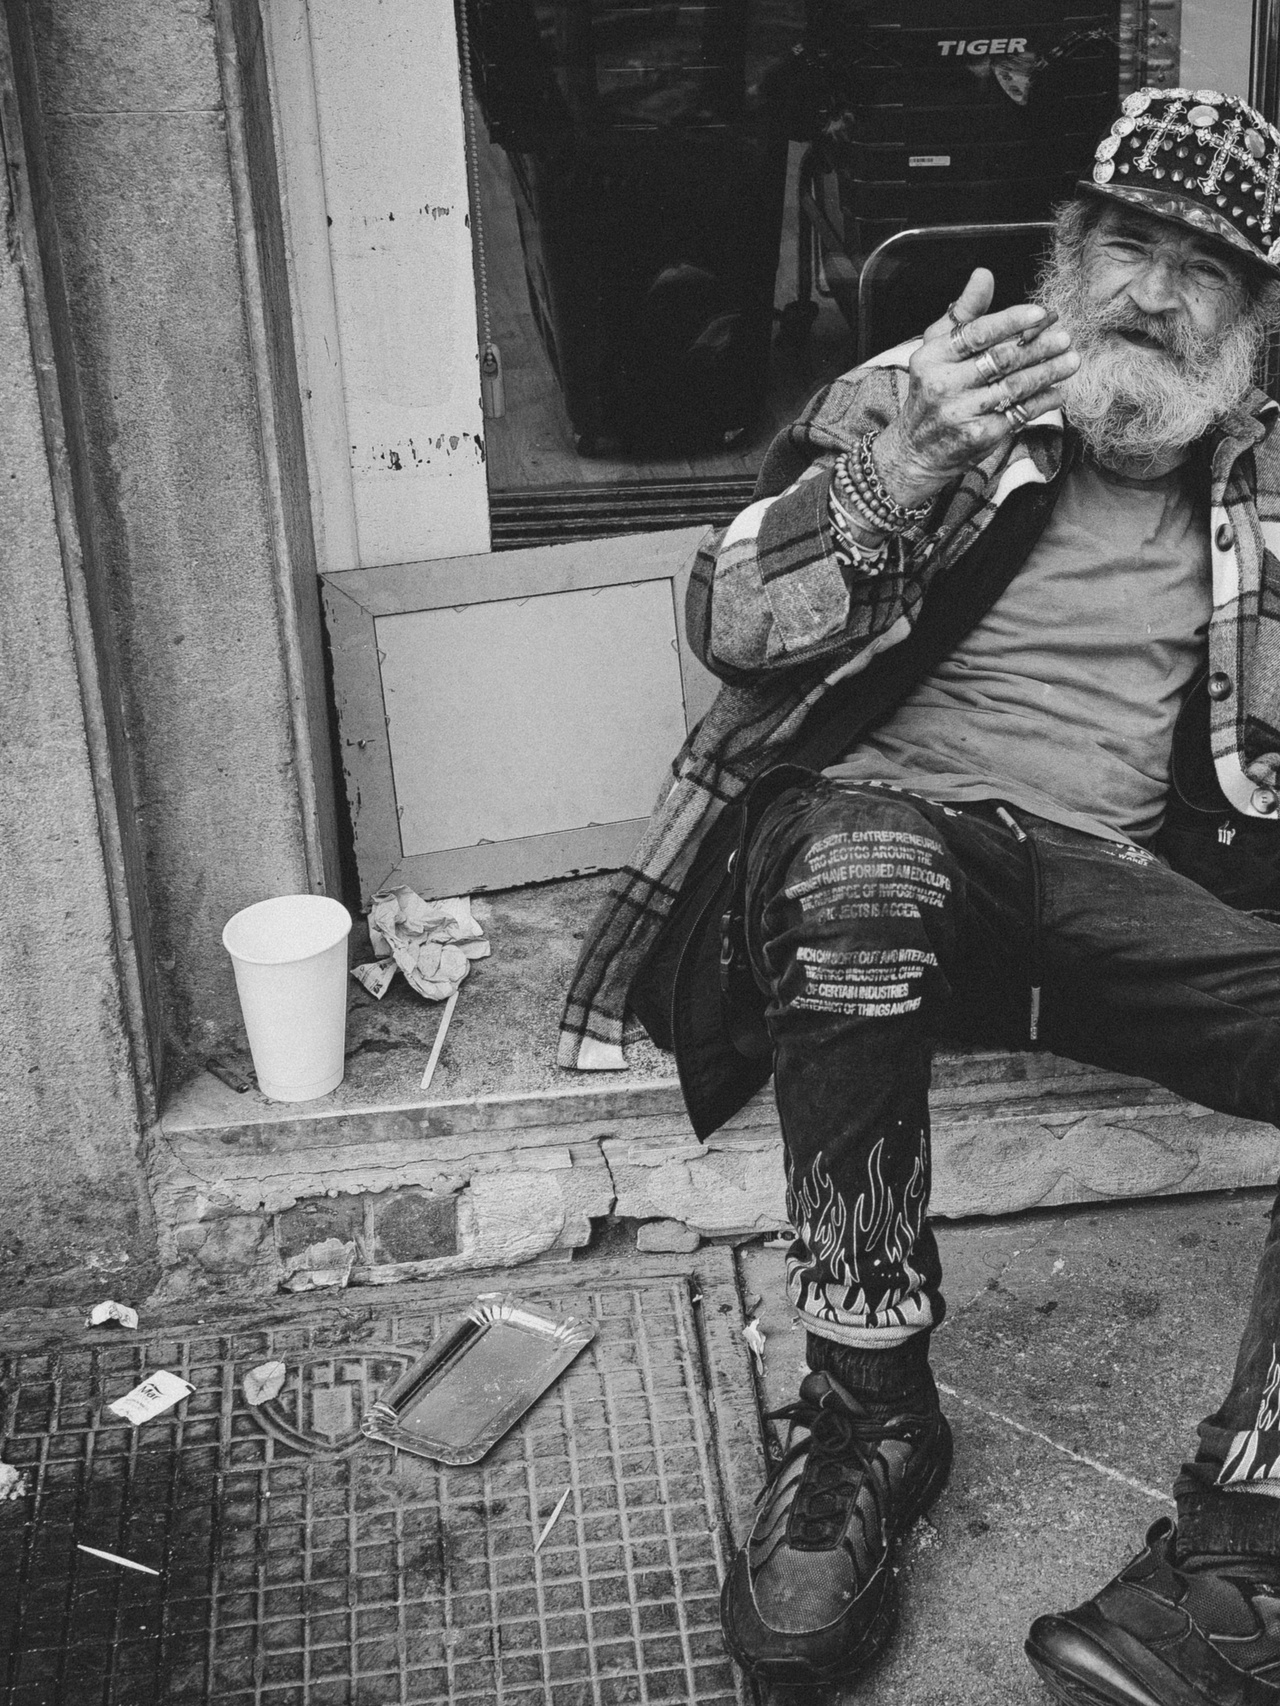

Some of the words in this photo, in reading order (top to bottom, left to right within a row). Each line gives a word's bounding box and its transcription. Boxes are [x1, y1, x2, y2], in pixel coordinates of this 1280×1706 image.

[937, 37, 1028, 56] TIGER
[821, 865, 848, 885] HAVE
[849, 863, 895, 879] FORMED
[818, 983, 858, 1000] CERTAIN
[858, 982, 910, 1000] INDUSTRIES
[857, 1001, 891, 1018] THINGS
